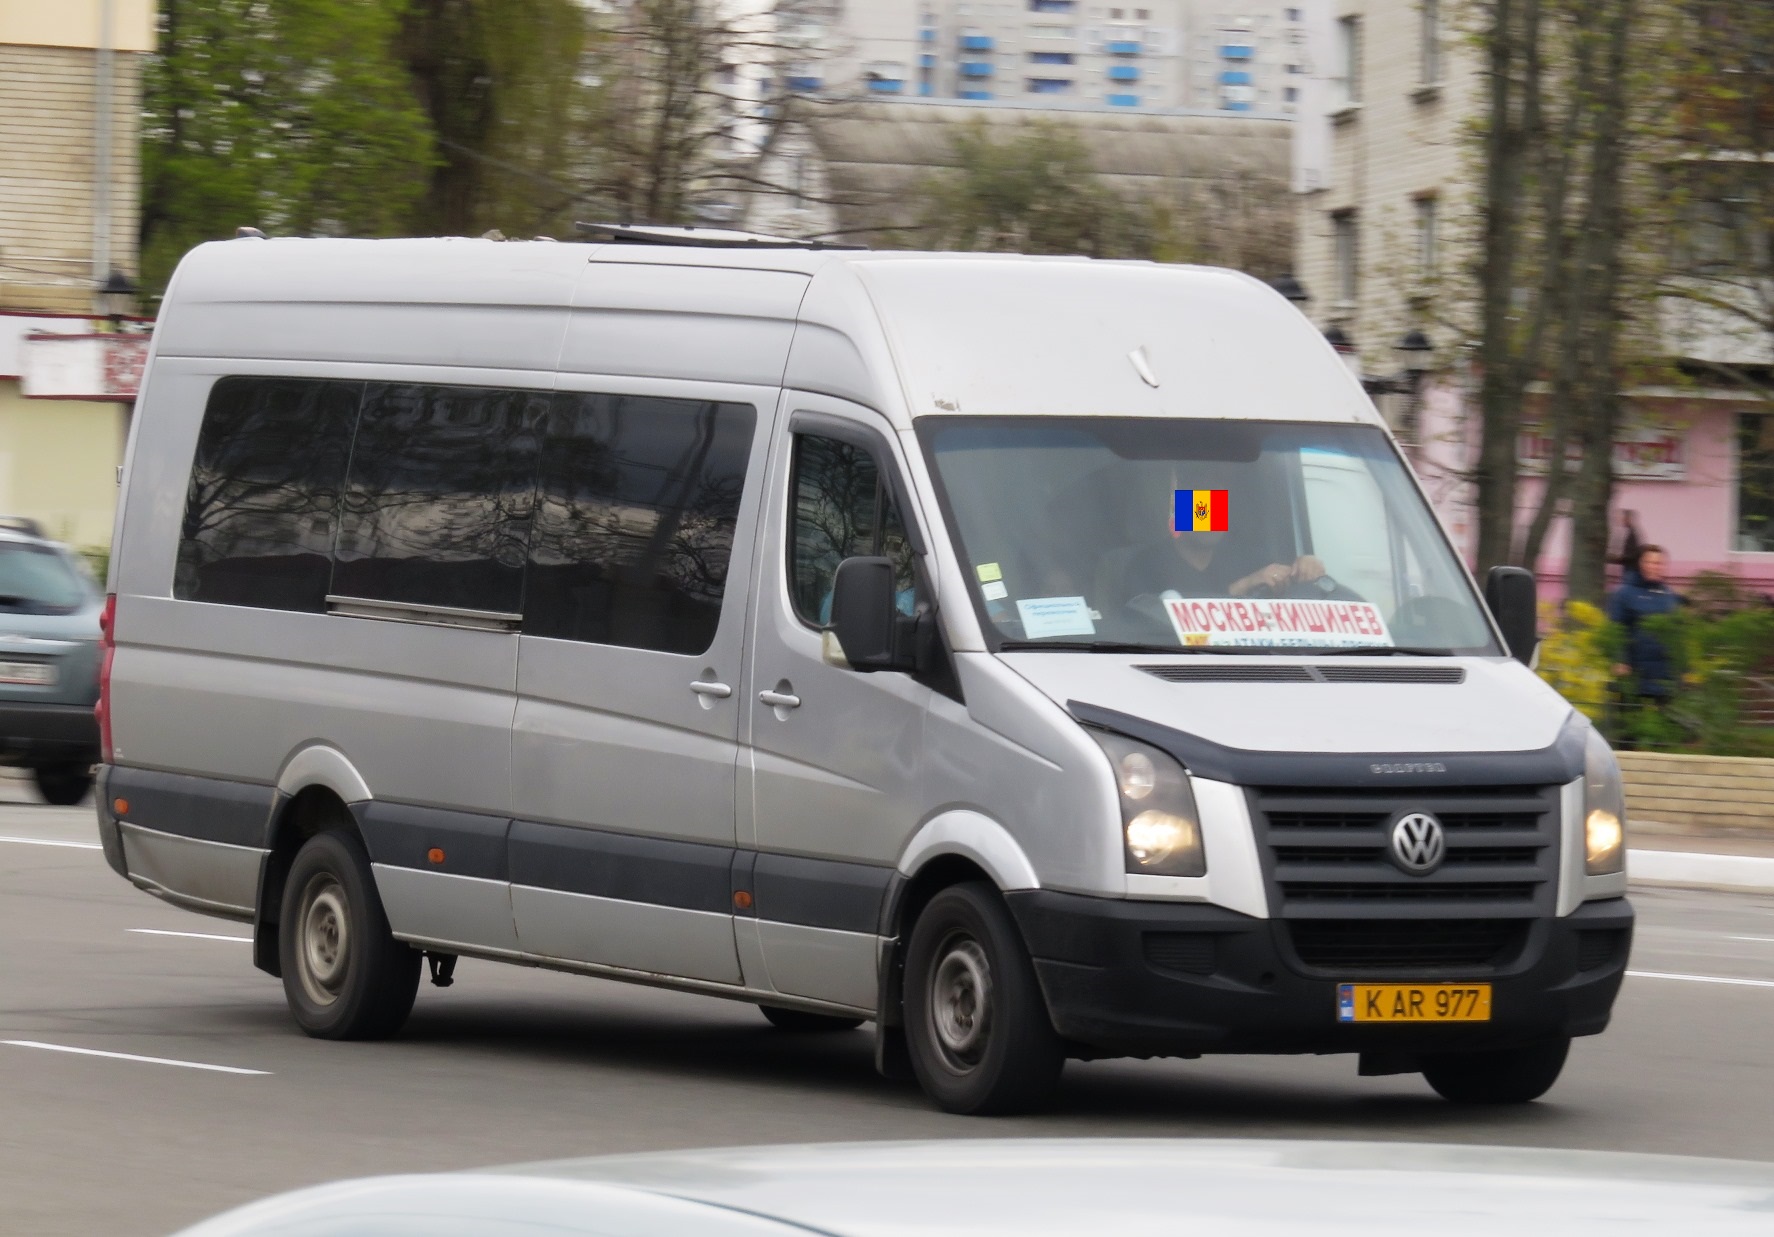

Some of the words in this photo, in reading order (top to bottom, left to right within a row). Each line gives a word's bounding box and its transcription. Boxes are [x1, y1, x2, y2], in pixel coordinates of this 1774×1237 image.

[1366, 989, 1383, 1018] K
[1392, 989, 1425, 1018] AR
[1435, 989, 1480, 1017] 977
